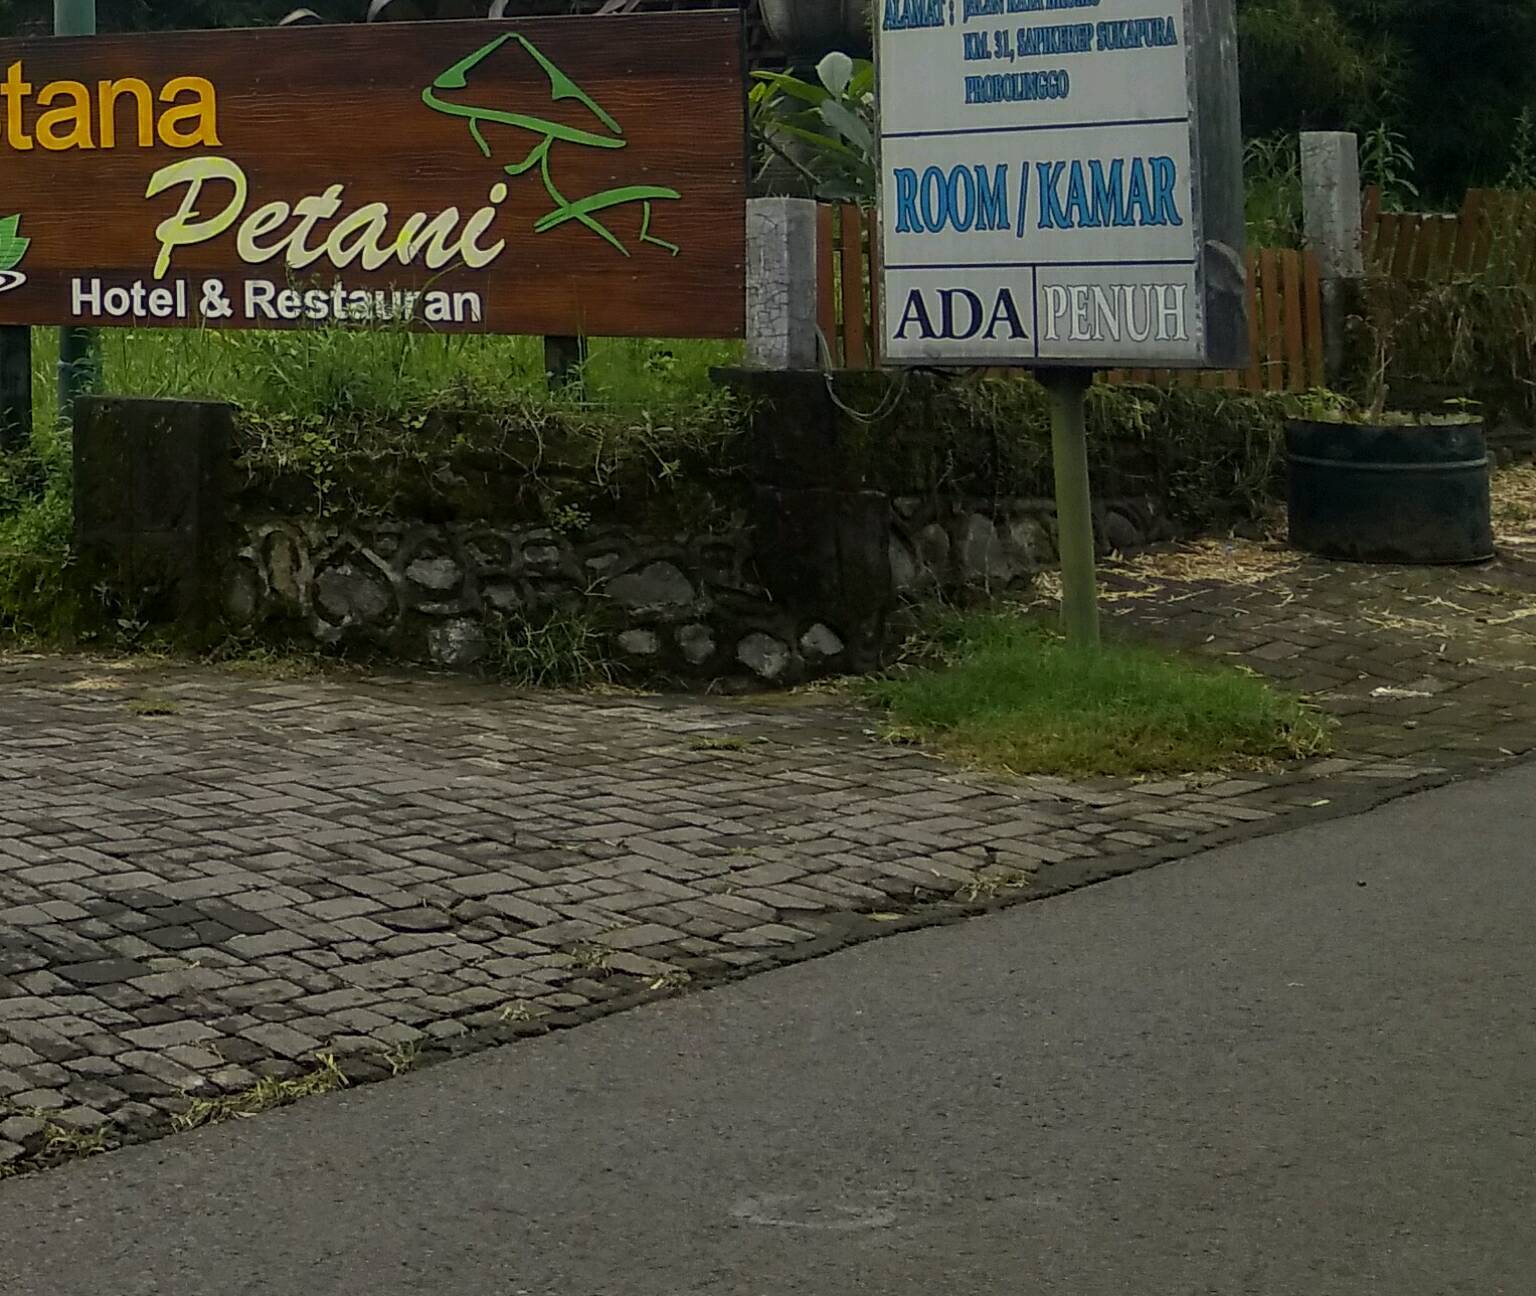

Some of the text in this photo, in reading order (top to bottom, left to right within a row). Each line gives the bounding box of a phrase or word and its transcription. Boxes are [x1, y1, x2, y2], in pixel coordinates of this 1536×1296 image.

[1096, 16, 1178, 51] SUKAPURA
[965, 69, 1069, 104] PROBOLINGGO
[144, 155, 508, 280] Petani
[71, 277, 186, 317] Hotel
[199, 278, 233, 319] &
[893, 287, 1029, 342] ADA
[1042, 282, 1188, 342] PENUH
